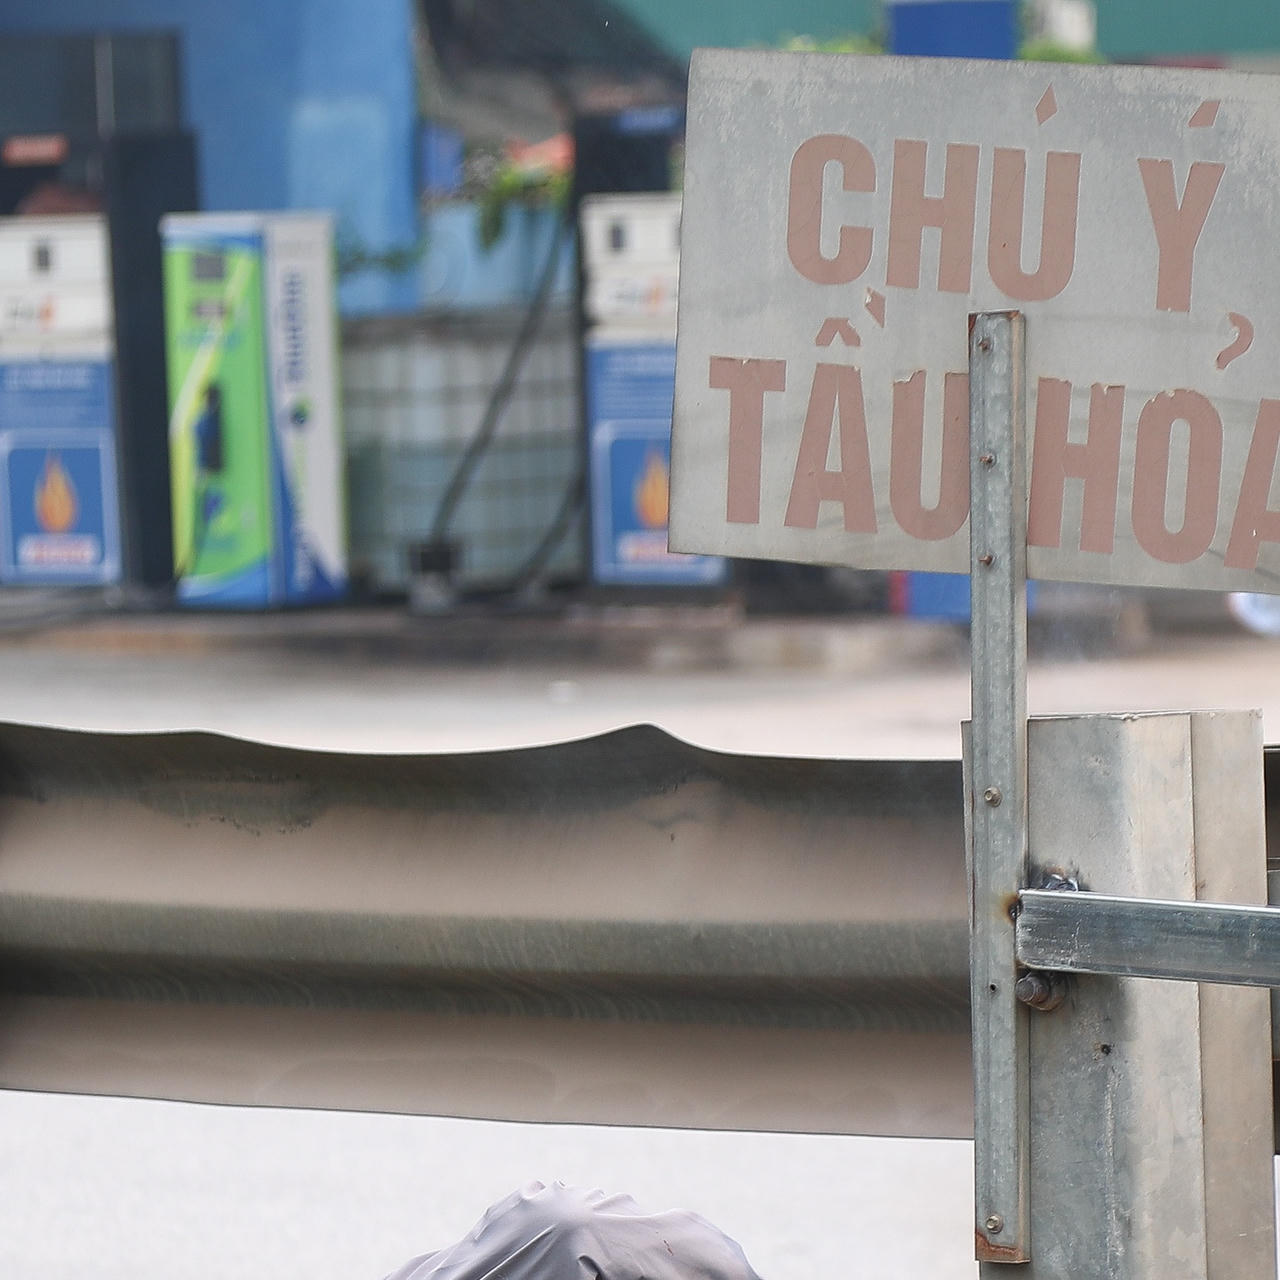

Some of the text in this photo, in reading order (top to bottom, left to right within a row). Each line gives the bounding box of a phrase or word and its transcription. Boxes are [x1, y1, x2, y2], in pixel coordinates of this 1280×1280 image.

[786, 83, 1226, 312] CHÚ Ý
[709, 287, 971, 541] TẦU
